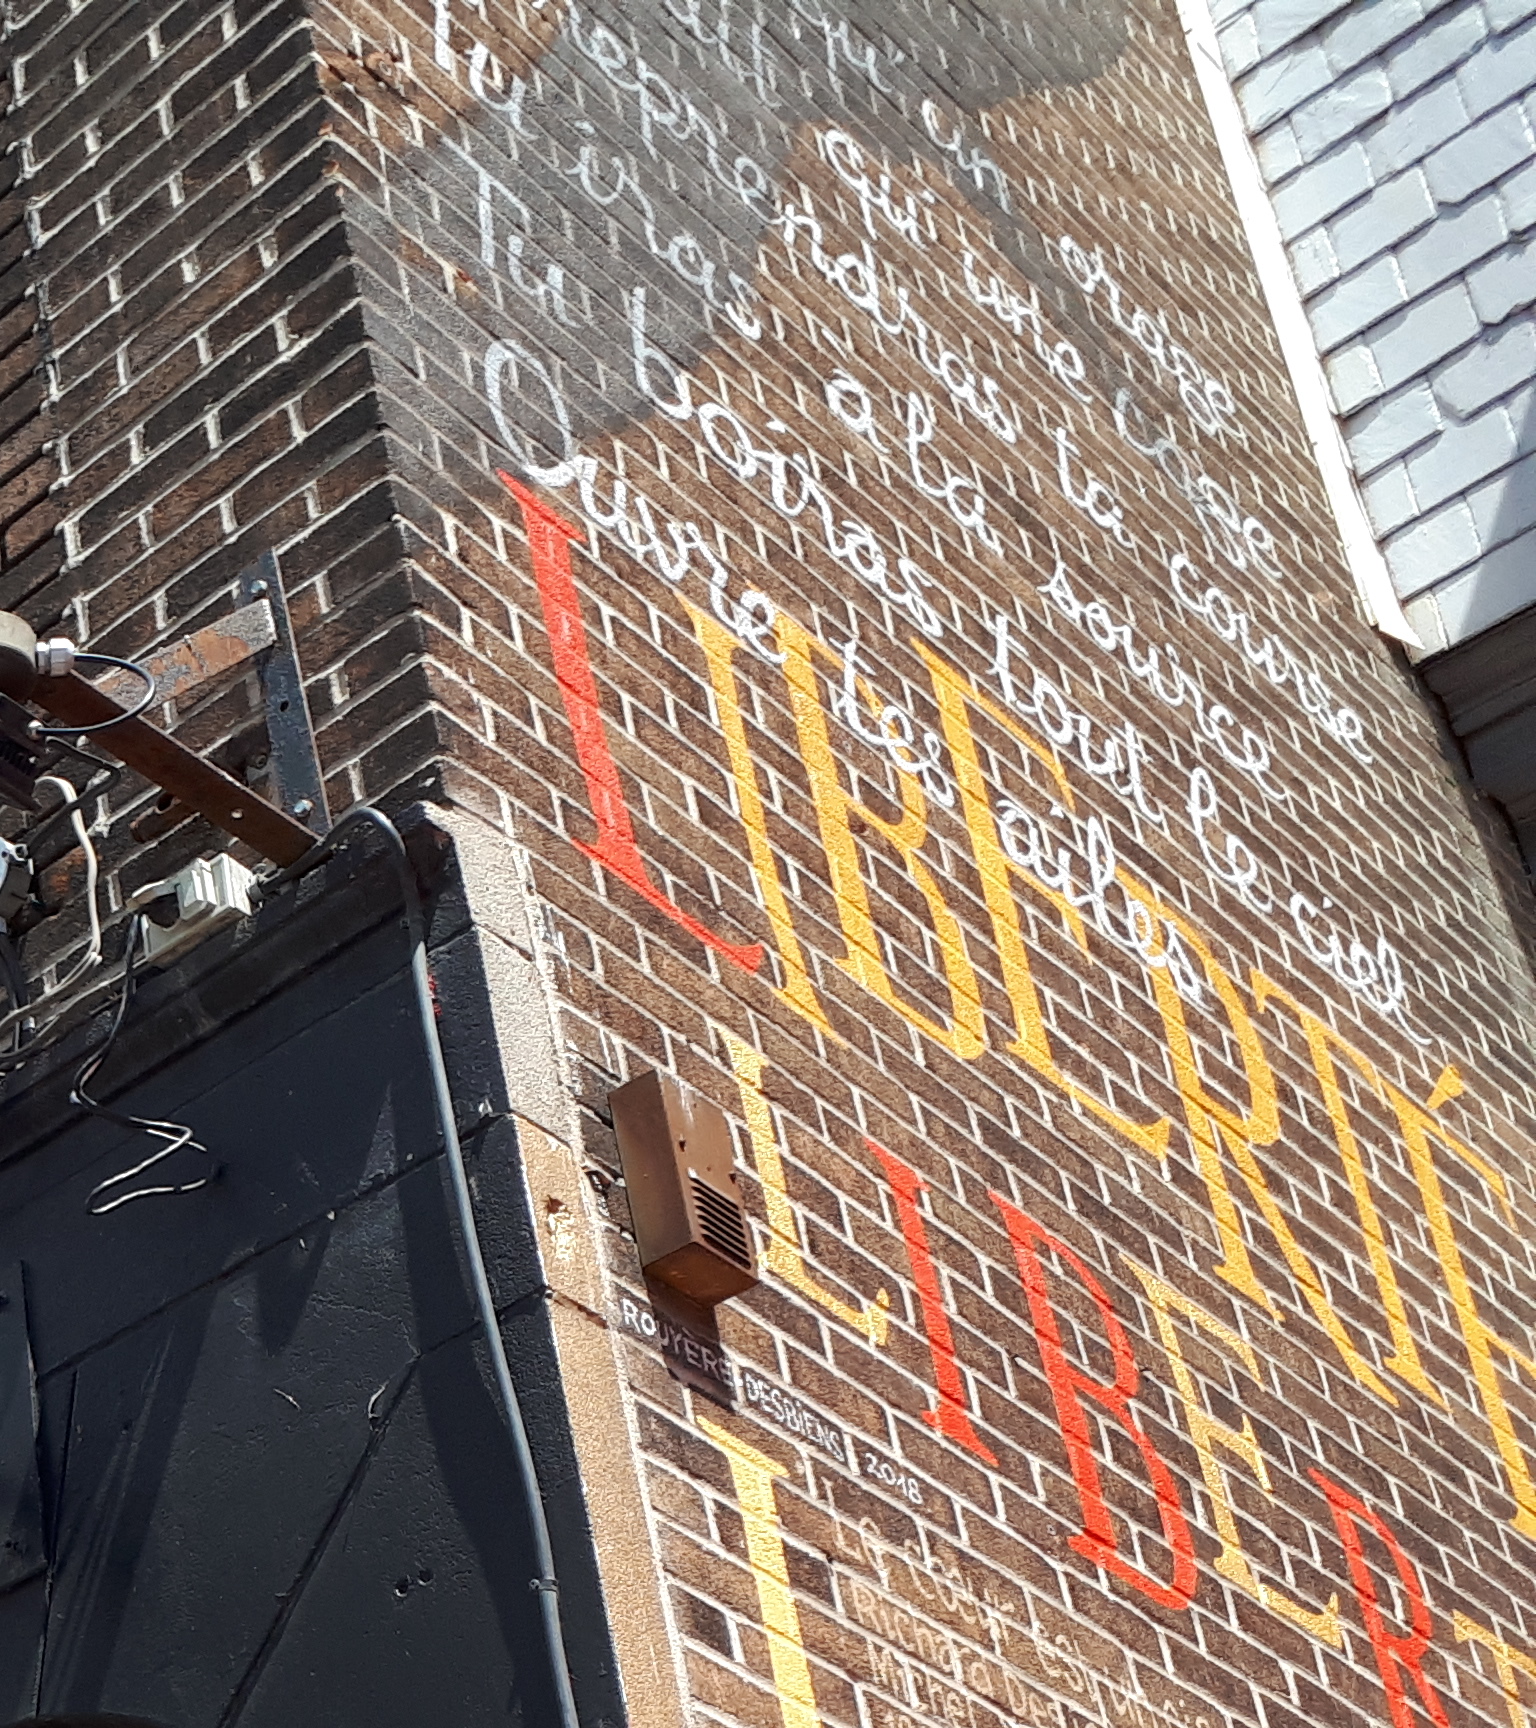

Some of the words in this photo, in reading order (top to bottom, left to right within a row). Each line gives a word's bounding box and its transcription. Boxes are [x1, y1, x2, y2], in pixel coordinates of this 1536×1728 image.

[436, 133, 584, 328] Tu
[630, 286, 943, 638] boiras
[984, 615, 1164, 825] tout
[1187, 766, 1273, 913] le
[1288, 892, 1433, 1045] ciel
[904, 391, 1004, 558] la
[1037, 558, 1288, 801] source
[1054, 426, 1136, 549] ta
[1169, 553, 1374, 766] course
[830, 636, 955, 808] tes
[993, 798, 1202, 1003] ailes
[865, 1451, 925, 1506] 2018
